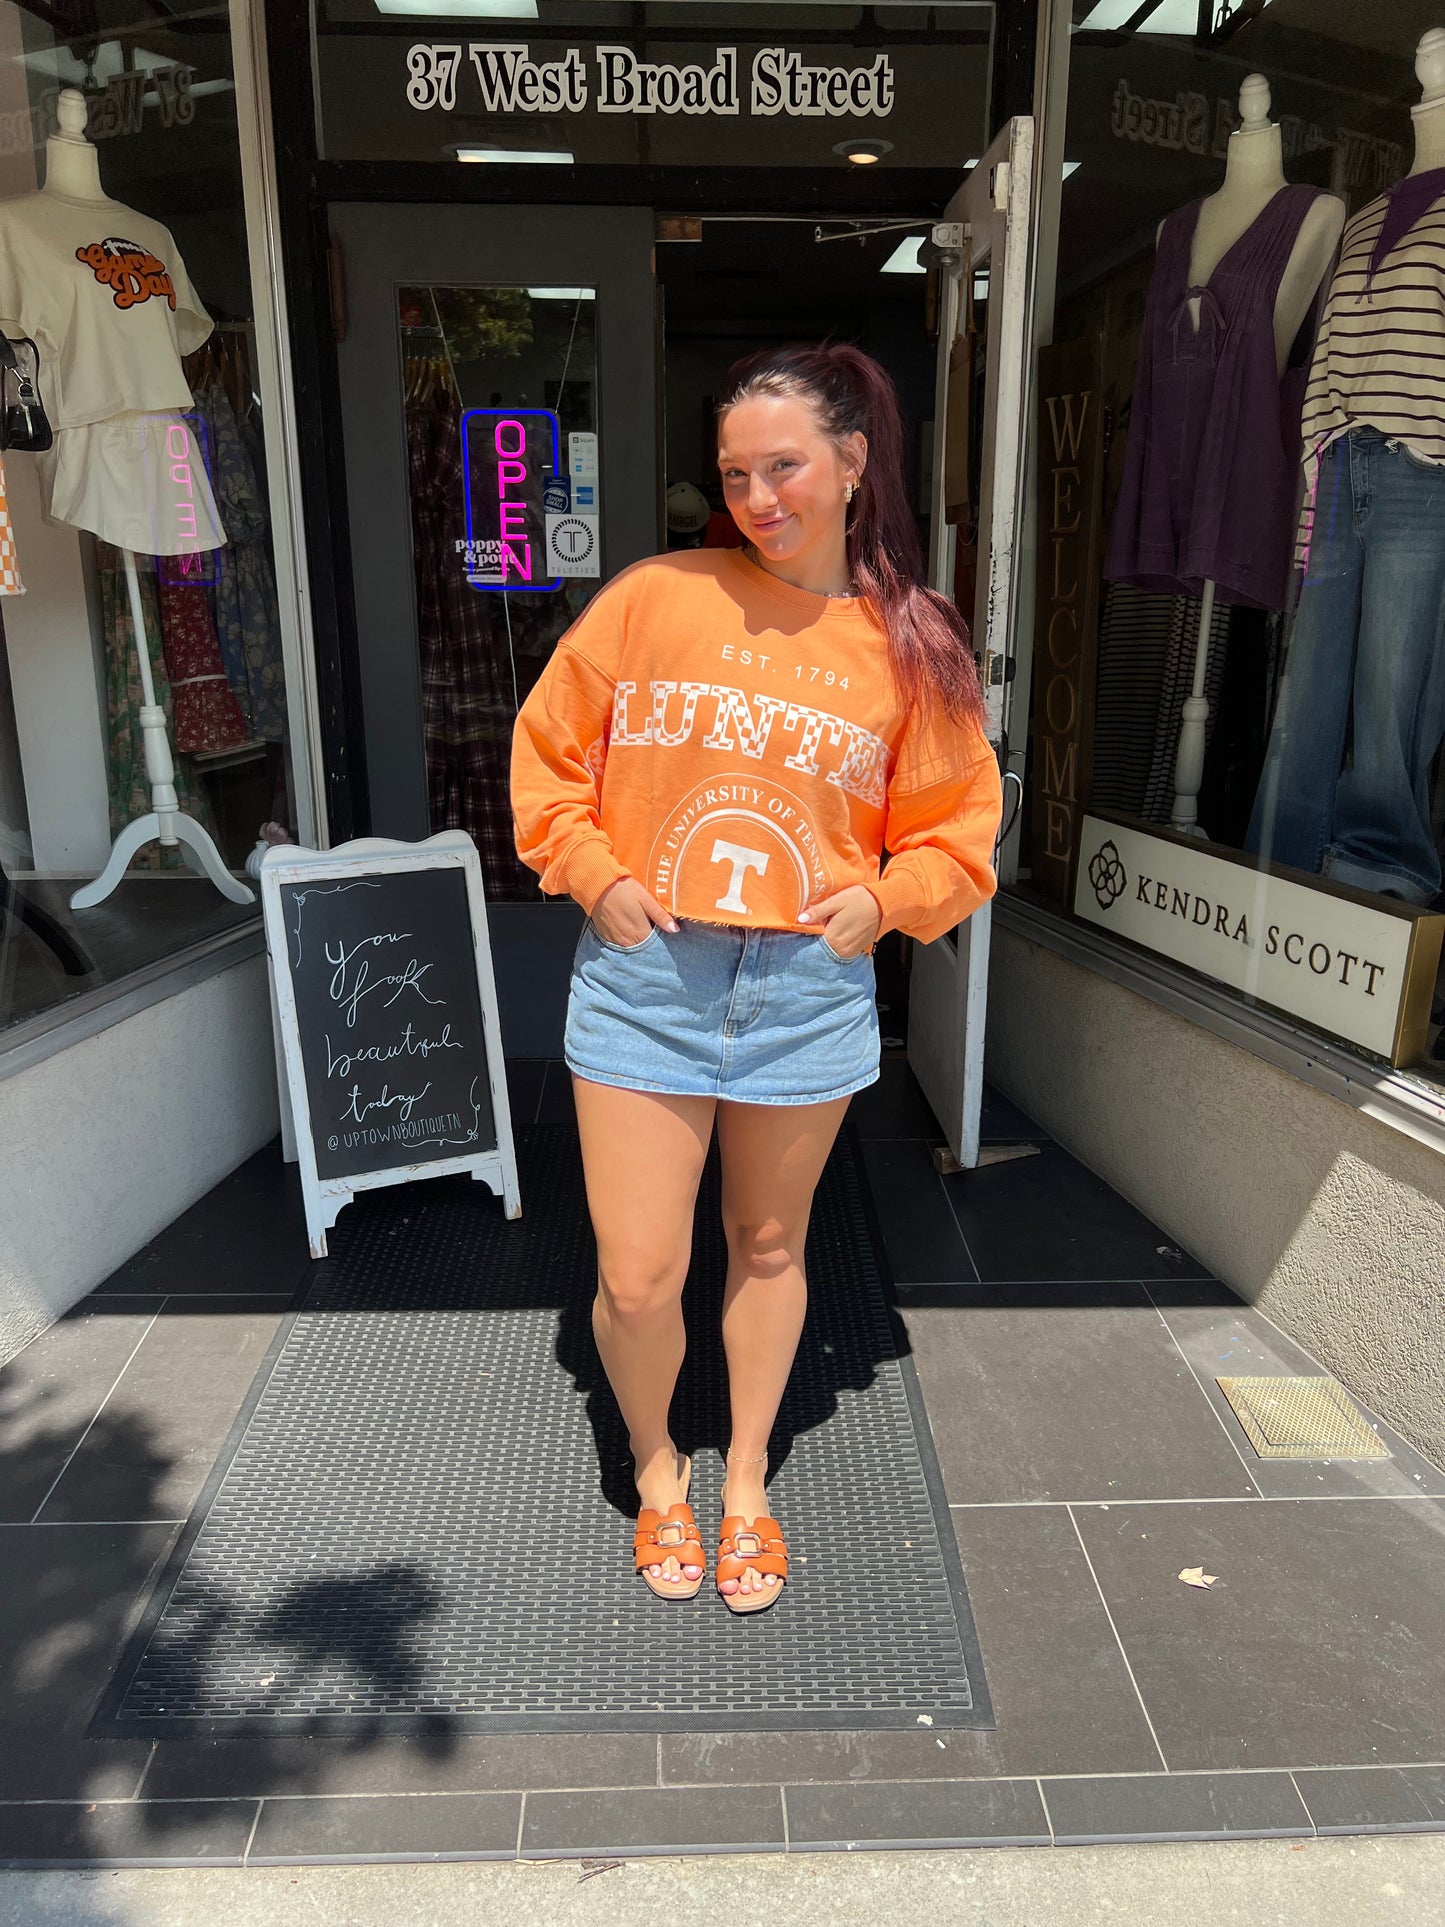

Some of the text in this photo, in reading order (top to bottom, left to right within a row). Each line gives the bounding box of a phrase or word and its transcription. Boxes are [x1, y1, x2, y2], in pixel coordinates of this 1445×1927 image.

[407, 43, 895, 118] 37 West Broad Street
[75, 243, 166, 284] Game
[110, 271, 176, 311] Day
[495, 420, 532, 581] OPEN
[454, 539, 506, 553] poppy
[1044, 391, 1094, 862] WELCOME
[721, 644, 850, 692] EST. 1794
[656, 854, 673, 897] THE
[667, 785, 764, 850] UNIVERSITY
[768, 797, 797, 821] OF
[710, 838, 770, 915] T
[325, 933, 413, 1001] you
[1136, 874, 1385, 997] KENDRA SCOTT
[338, 958, 447, 1028] look
[339, 1080, 433, 1122] today
